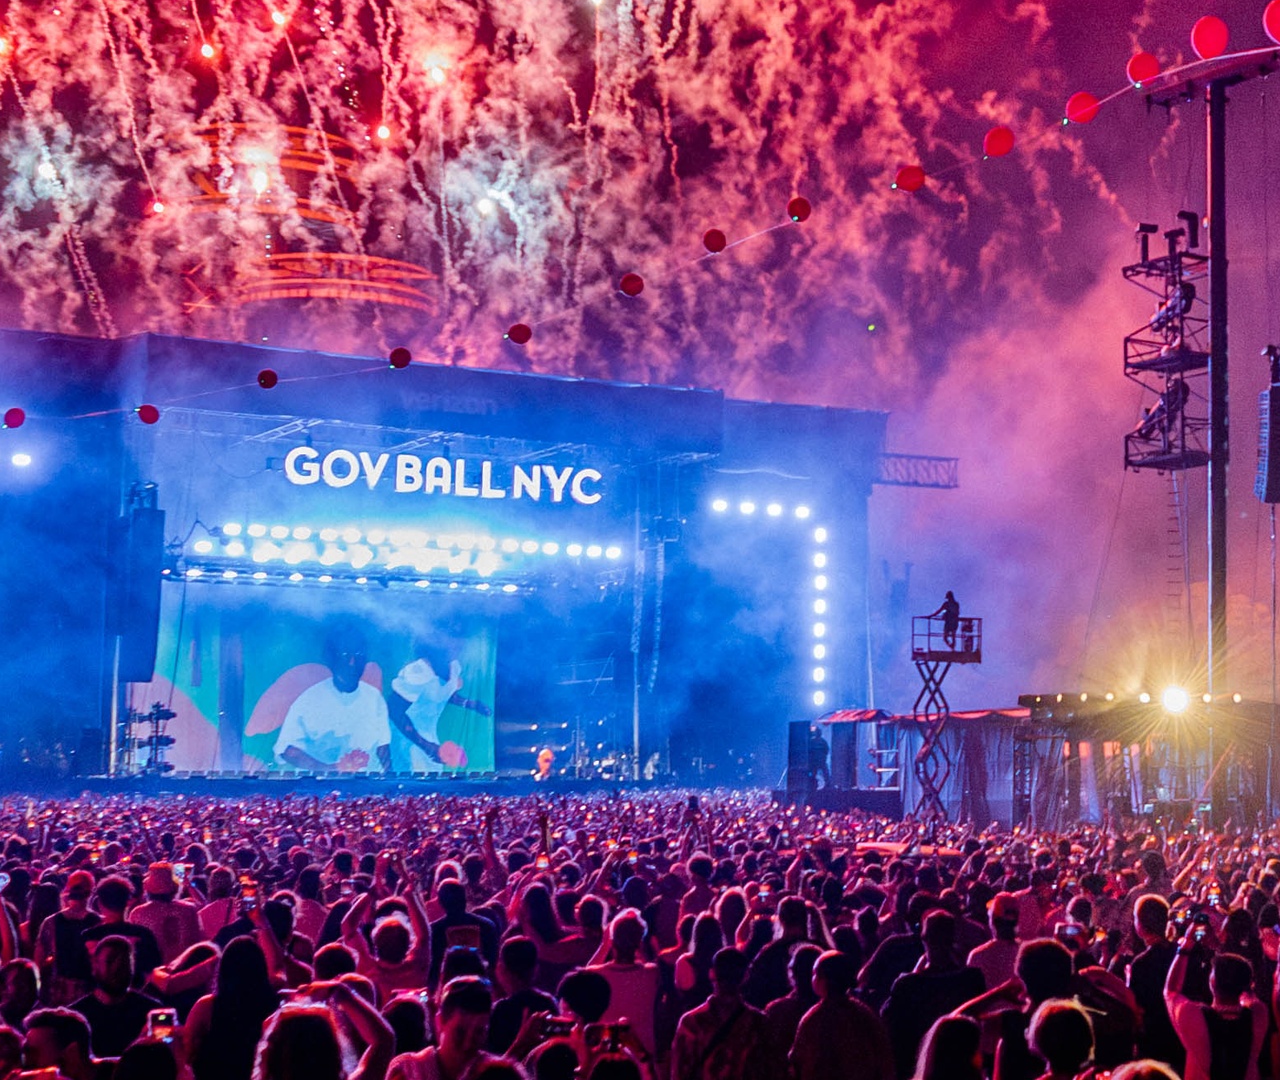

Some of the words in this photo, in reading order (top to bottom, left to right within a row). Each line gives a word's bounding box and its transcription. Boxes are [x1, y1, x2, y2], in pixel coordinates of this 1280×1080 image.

[284, 446, 389, 490] GOV
[395, 454, 505, 498] BALL
[513, 465, 602, 504] NYC
